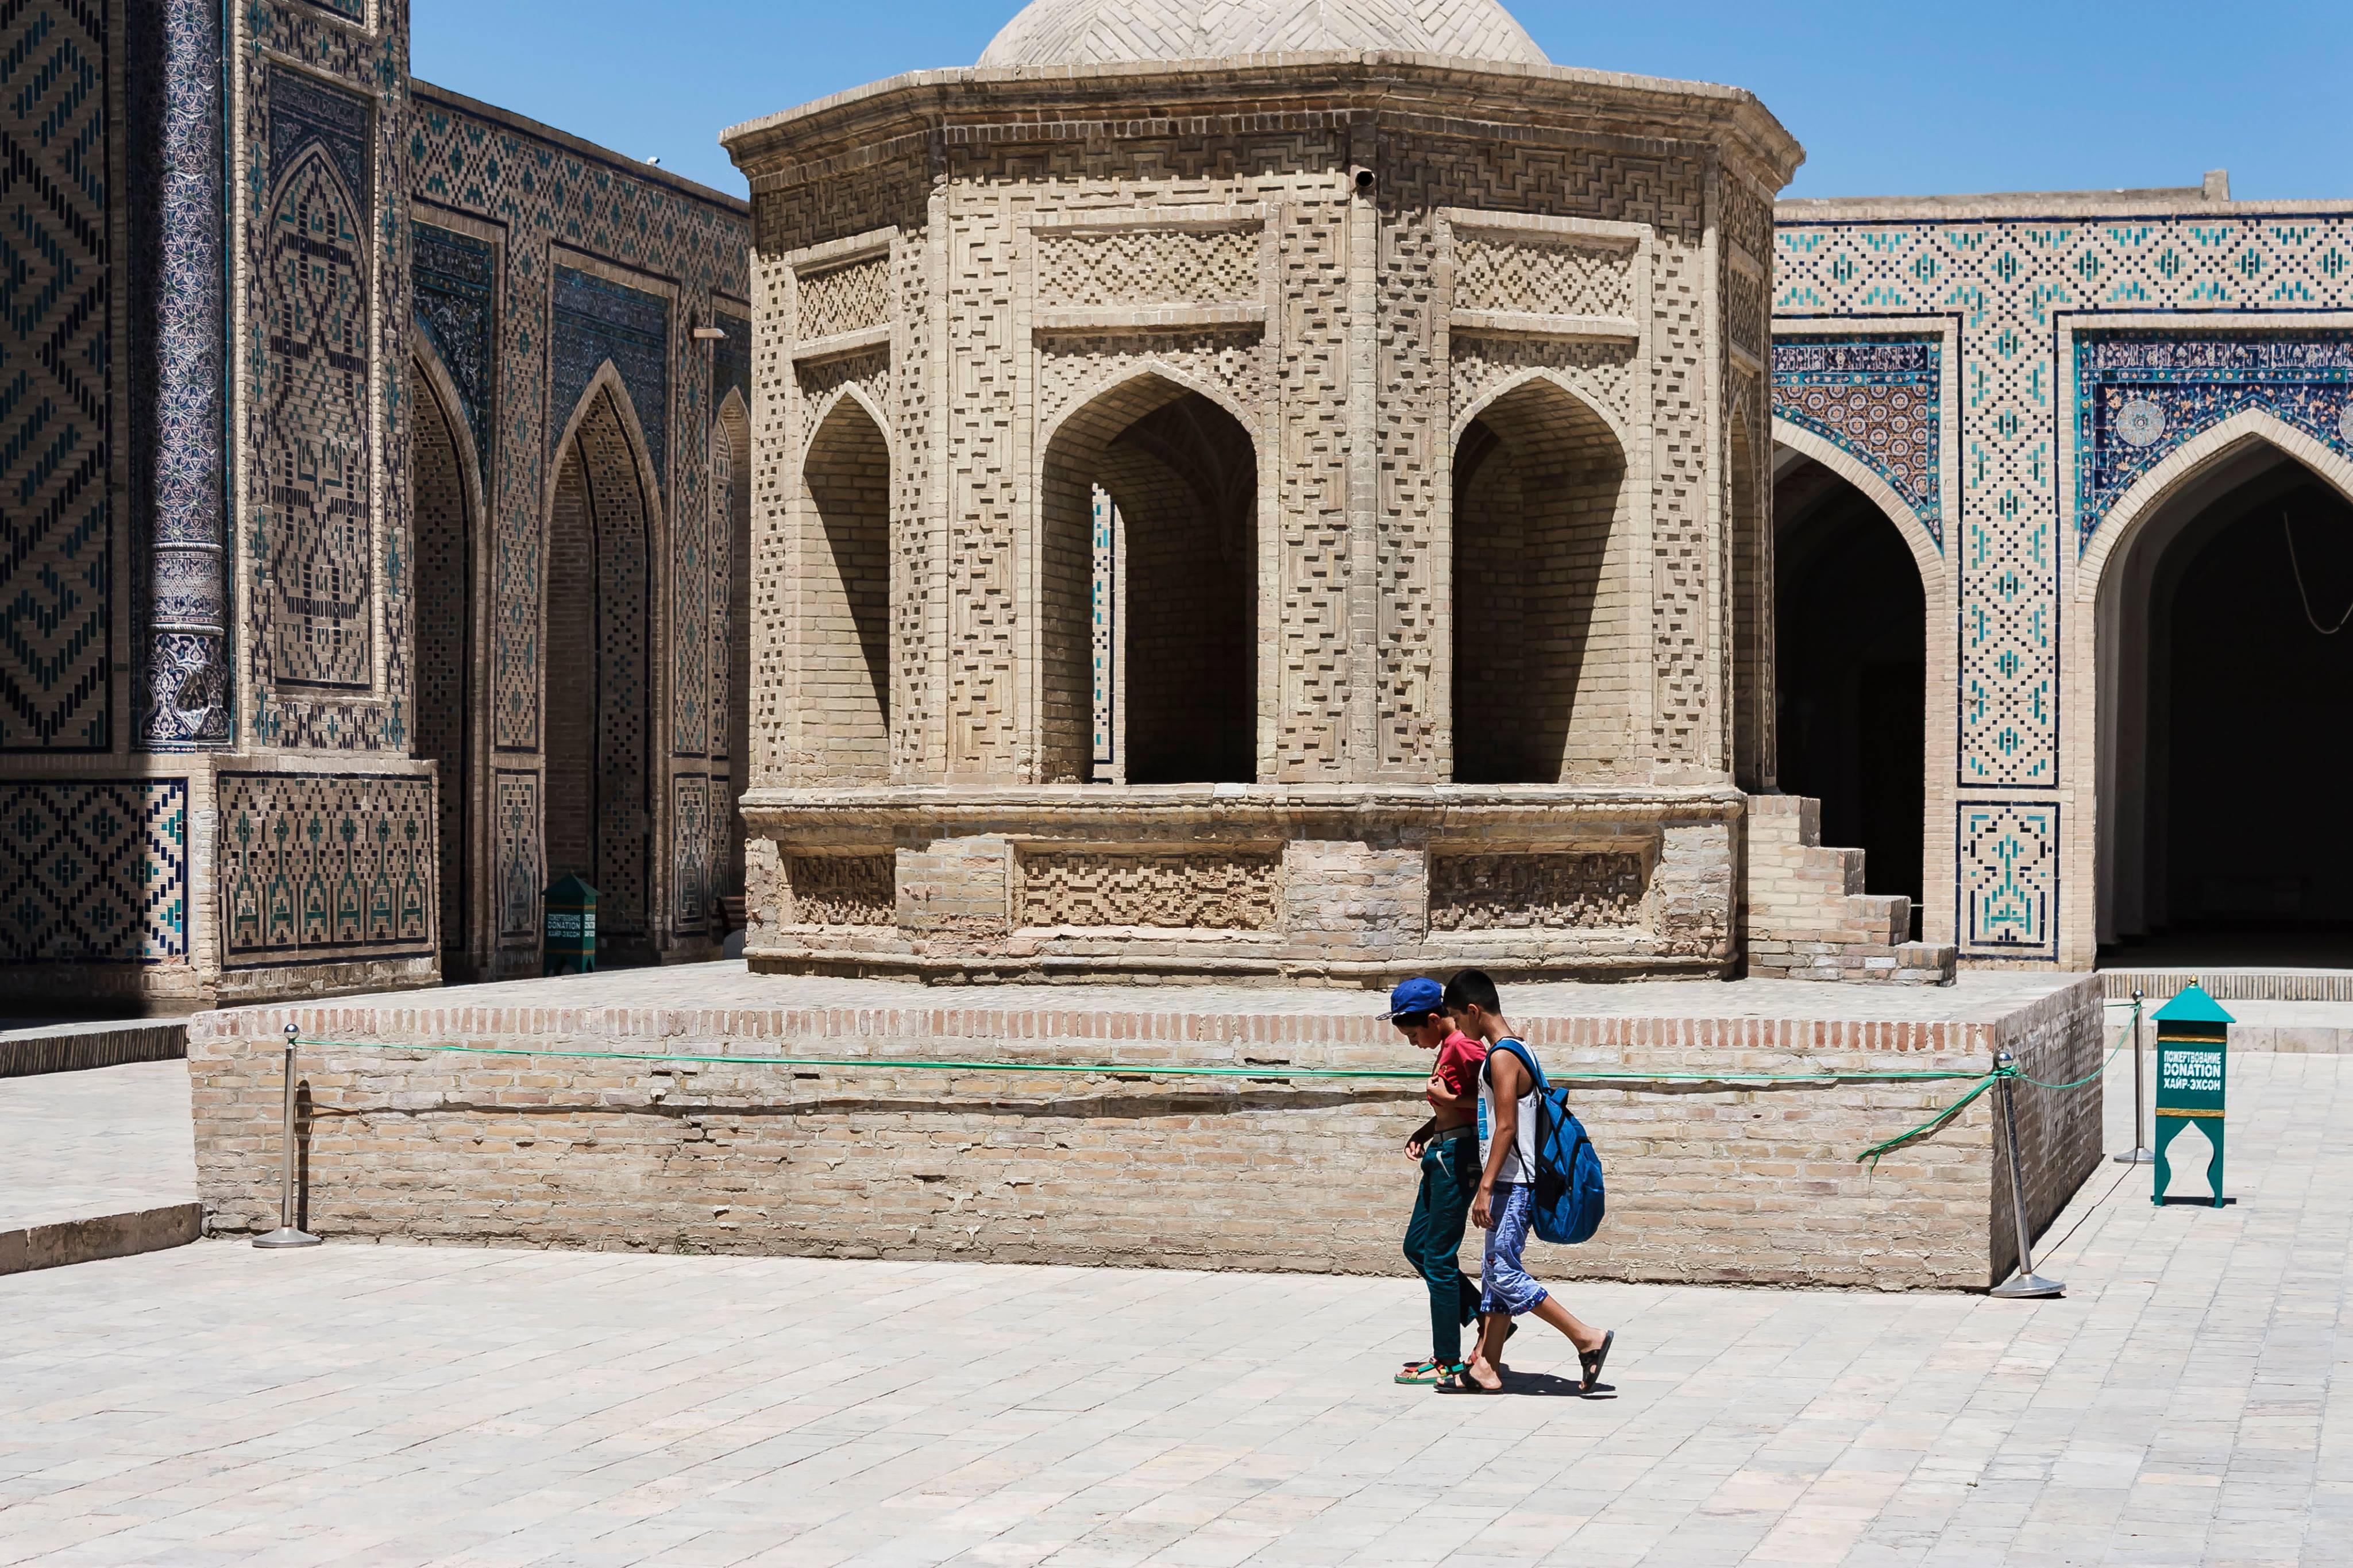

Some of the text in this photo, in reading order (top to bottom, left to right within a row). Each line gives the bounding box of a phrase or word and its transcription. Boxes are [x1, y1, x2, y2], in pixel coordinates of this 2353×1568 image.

[548, 921, 580, 929] DONATION
[2164, 1051, 2221, 1064] ПОЖЕРТВОВАНИЕ
[2163, 1063, 2221, 1077] DONATION
[2163, 1077, 2221, 1091] ХАЙР-ЭХСОН
